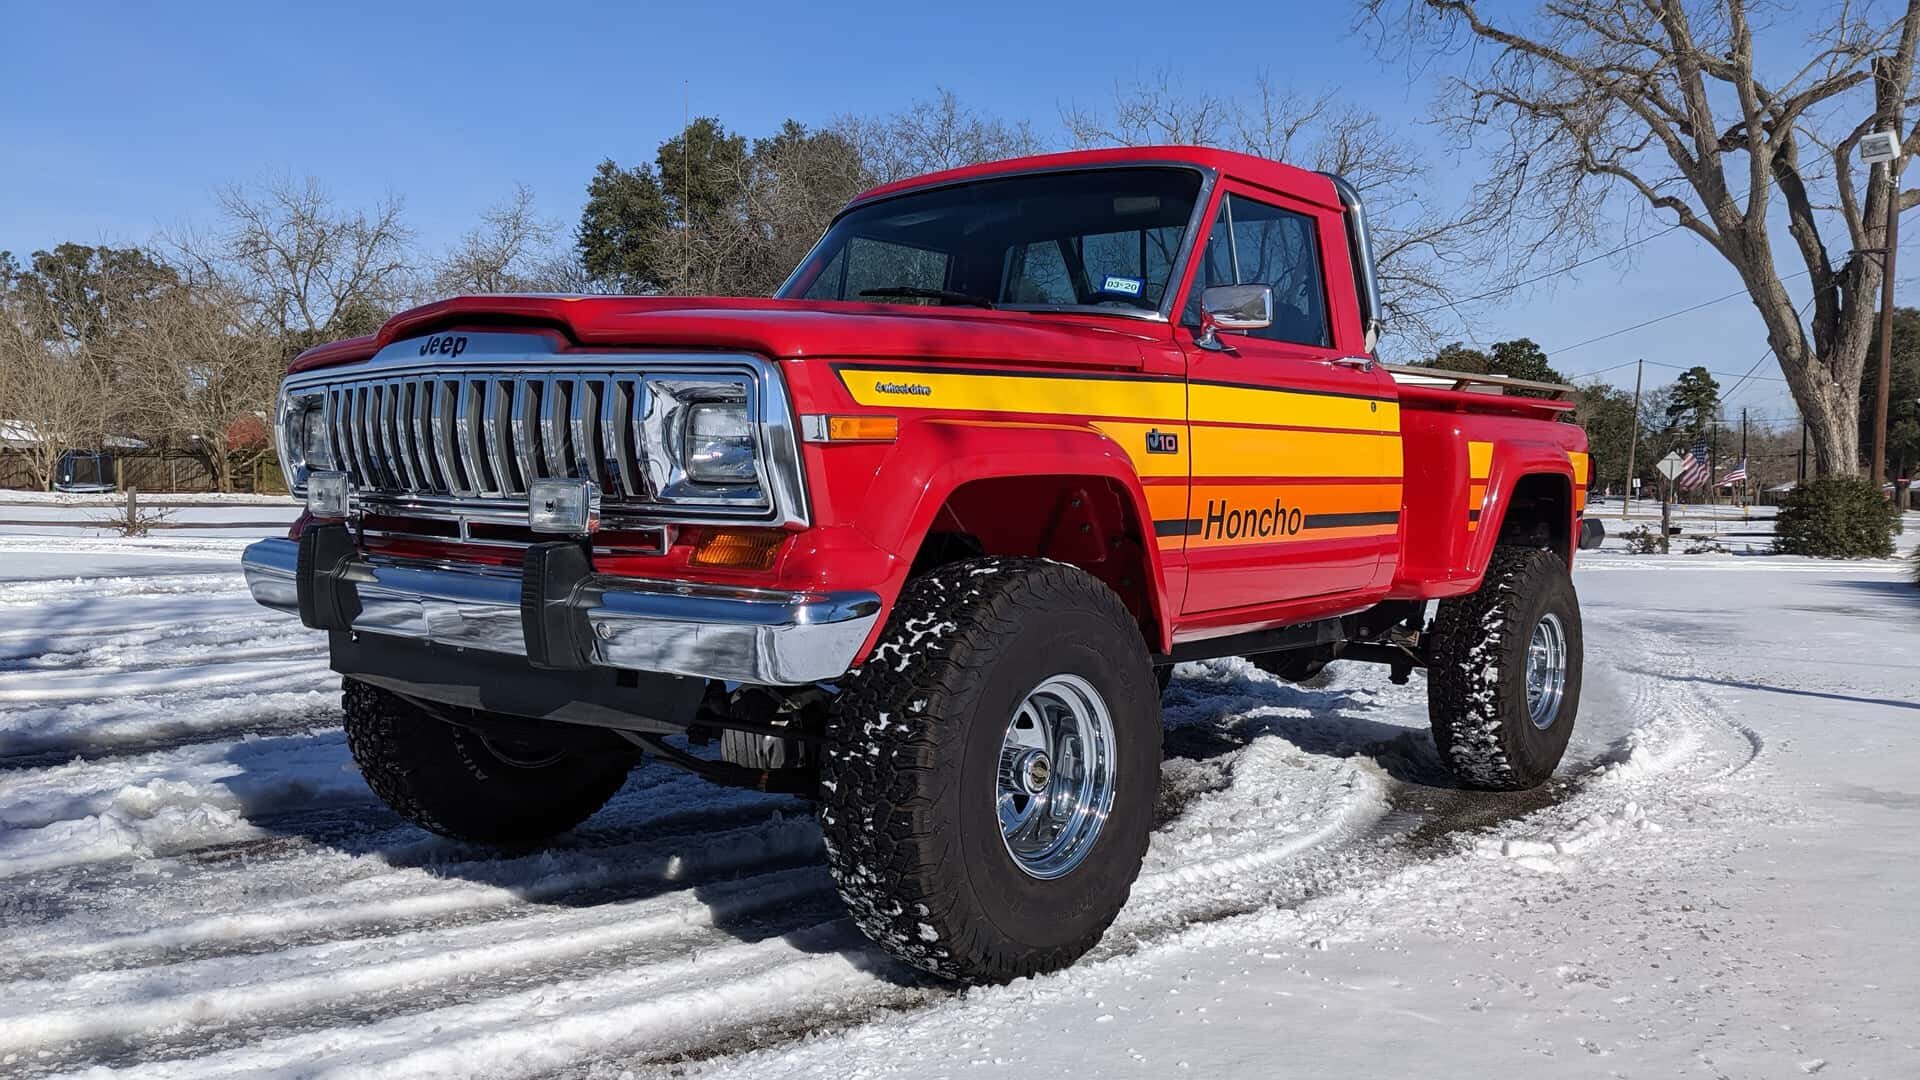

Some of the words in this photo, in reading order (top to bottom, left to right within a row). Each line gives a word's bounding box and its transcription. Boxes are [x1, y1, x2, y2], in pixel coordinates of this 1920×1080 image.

[420, 336, 468, 358] Jeep
[875, 381, 883, 393] 4
[883, 382, 909, 395] wheel
[910, 383, 931, 396] drive
[1204, 498, 1301, 540] Honcho
